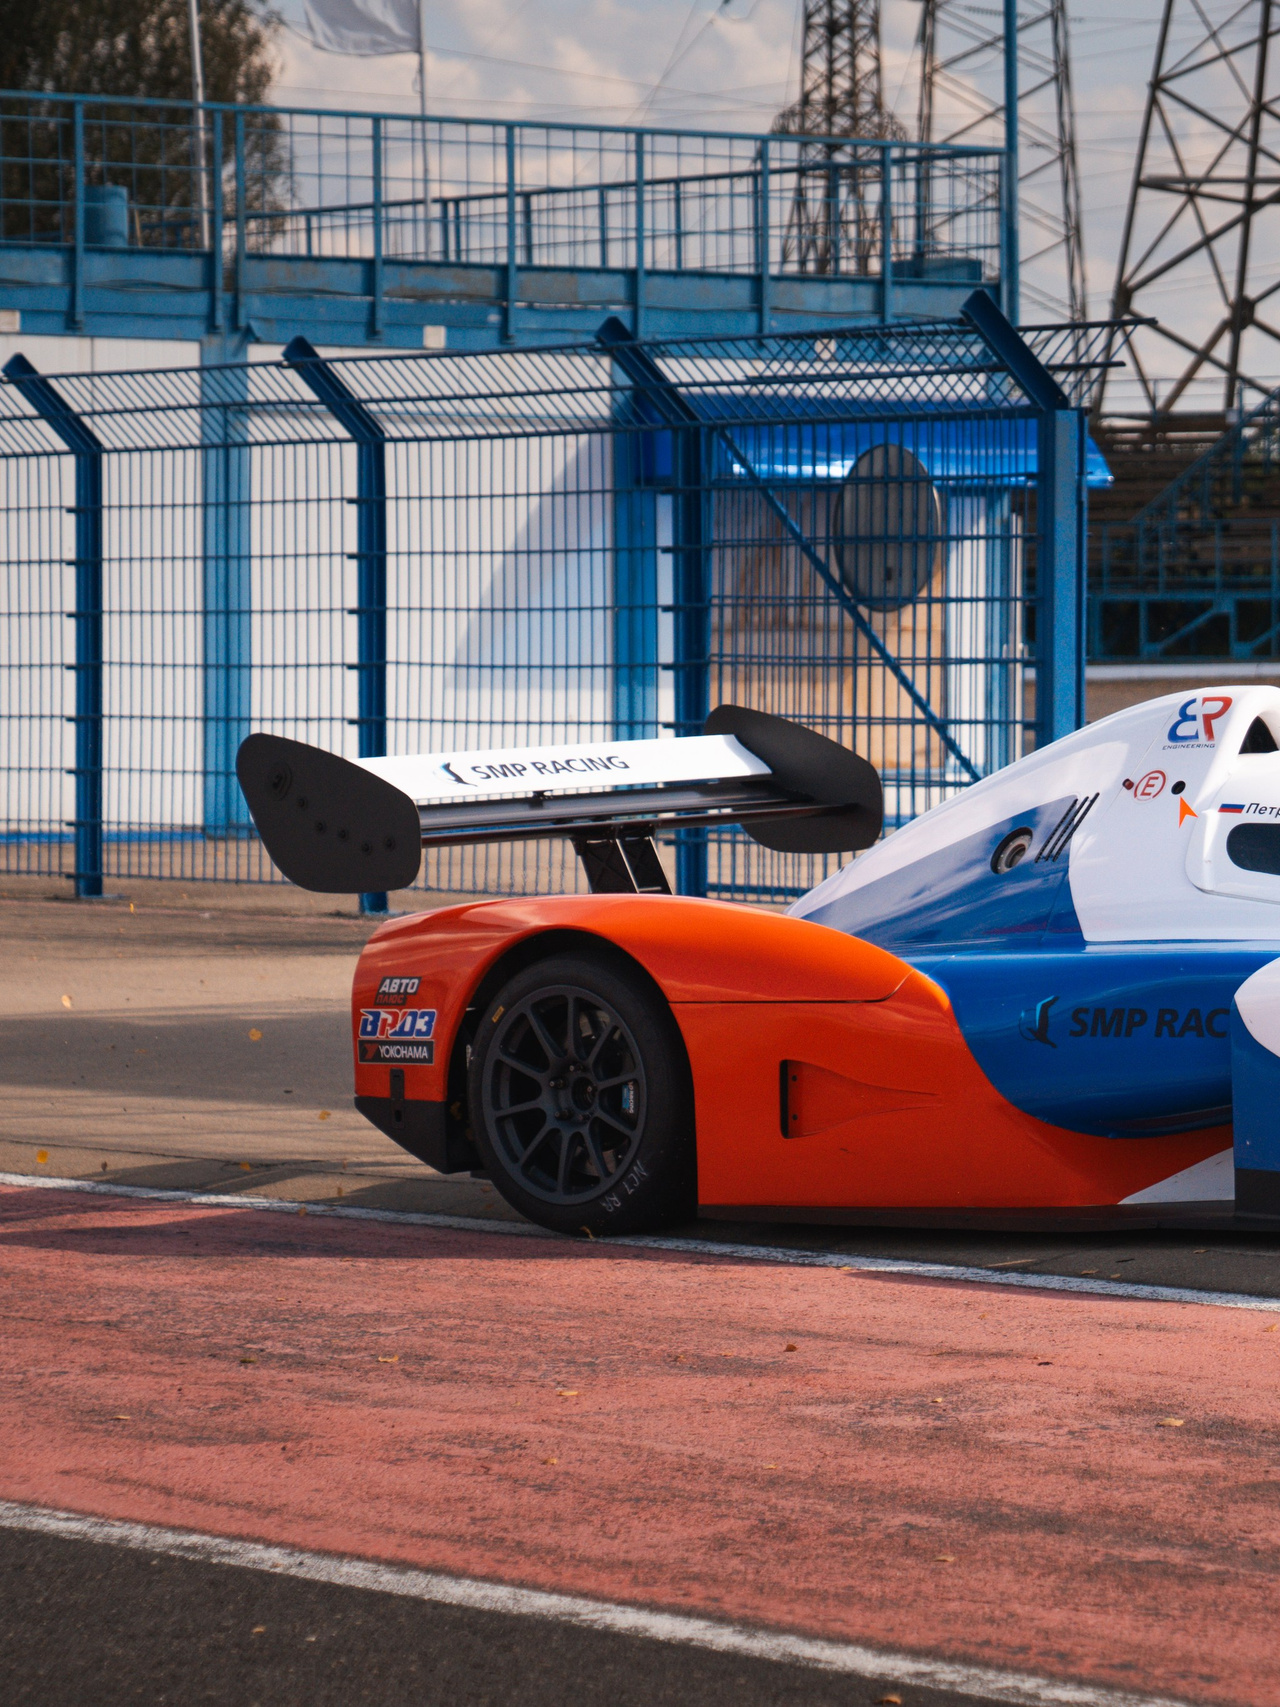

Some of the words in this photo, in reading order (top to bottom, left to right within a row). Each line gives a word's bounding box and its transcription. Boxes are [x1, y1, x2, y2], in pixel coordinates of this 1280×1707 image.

[1162, 743, 1216, 751] ENGINEERING
[470, 762, 528, 780] SMP
[530, 755, 630, 775] RACING
[1140, 776, 1160, 796] E
[379, 978, 420, 994] АВТО
[376, 994, 405, 1004] ПЛЮС
[1069, 1007, 1148, 1038] SMP
[379, 1045, 429, 1059] YOKOHAMA
